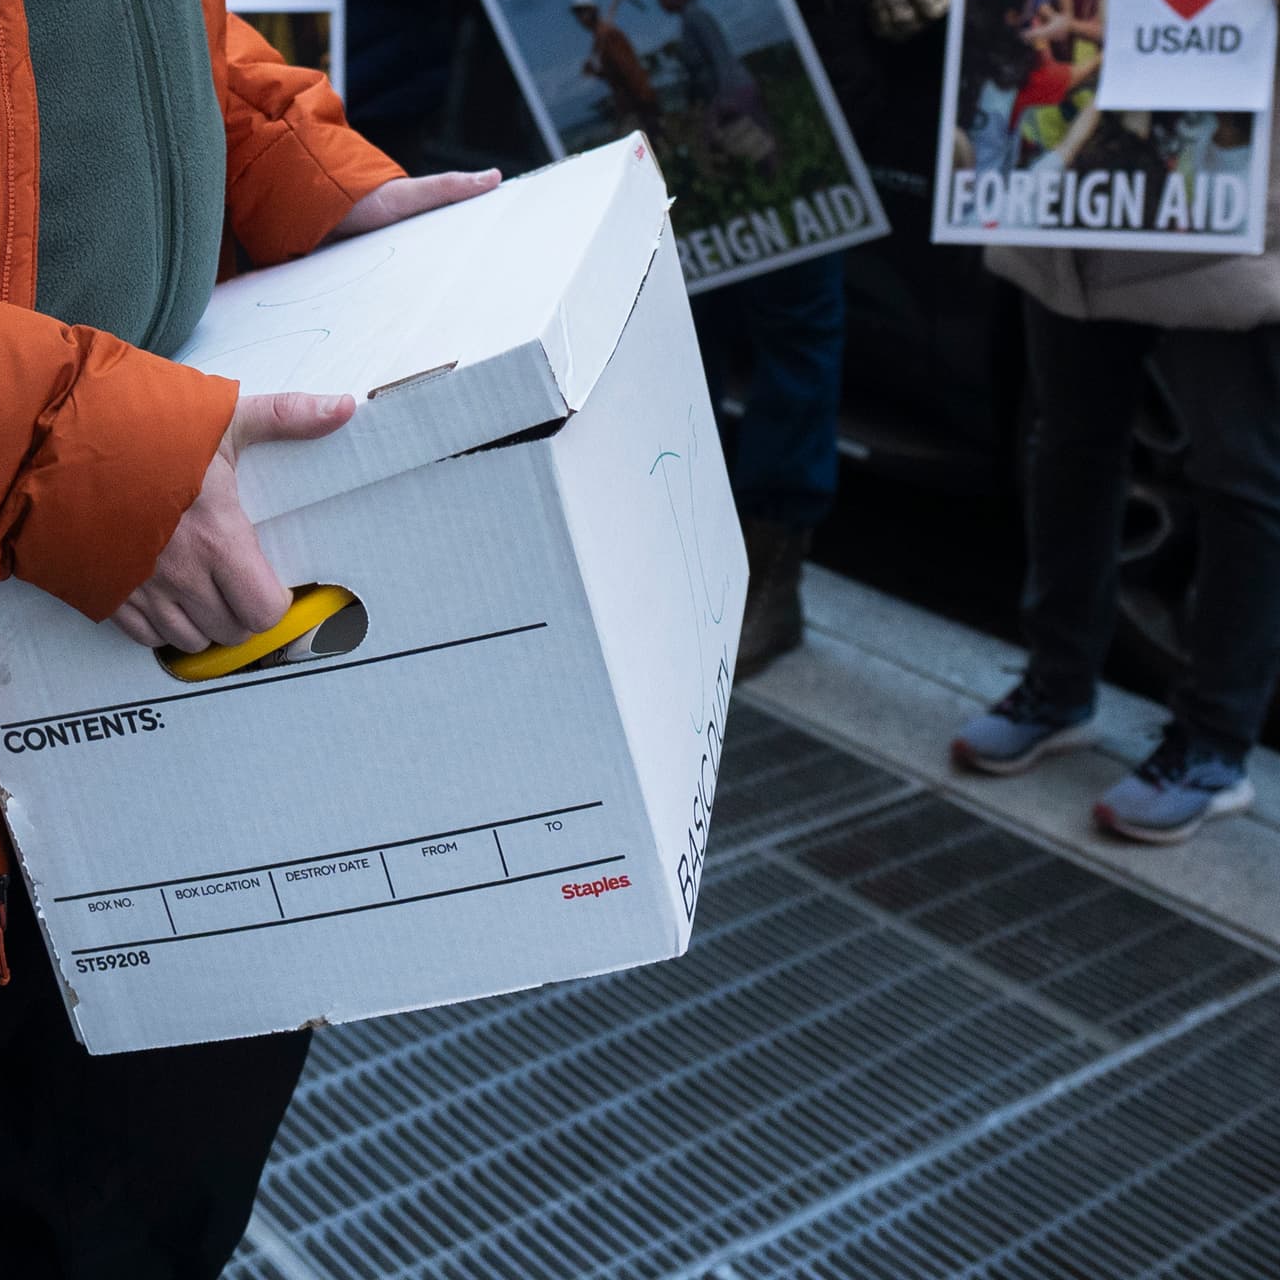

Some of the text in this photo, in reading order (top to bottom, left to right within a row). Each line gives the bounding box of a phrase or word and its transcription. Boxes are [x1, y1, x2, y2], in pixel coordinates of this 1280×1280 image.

[1135, 24, 1243, 54] USAID
[950, 169, 1246, 231] FOREIGN AID
[790, 184, 865, 243] AID
[3, 707, 166, 754] CONTENTS:
[544, 820, 563, 832] TO
[677, 753, 714, 923] BASIC
[421, 841, 458, 857] FROM
[285, 858, 370, 882] DESTROY DATE
[175, 877, 261, 900] BOX LOCATION
[561, 875, 631, 900] Staples
[88, 897, 135, 913] BOX NO.
[75, 950, 151, 974] ST59208
